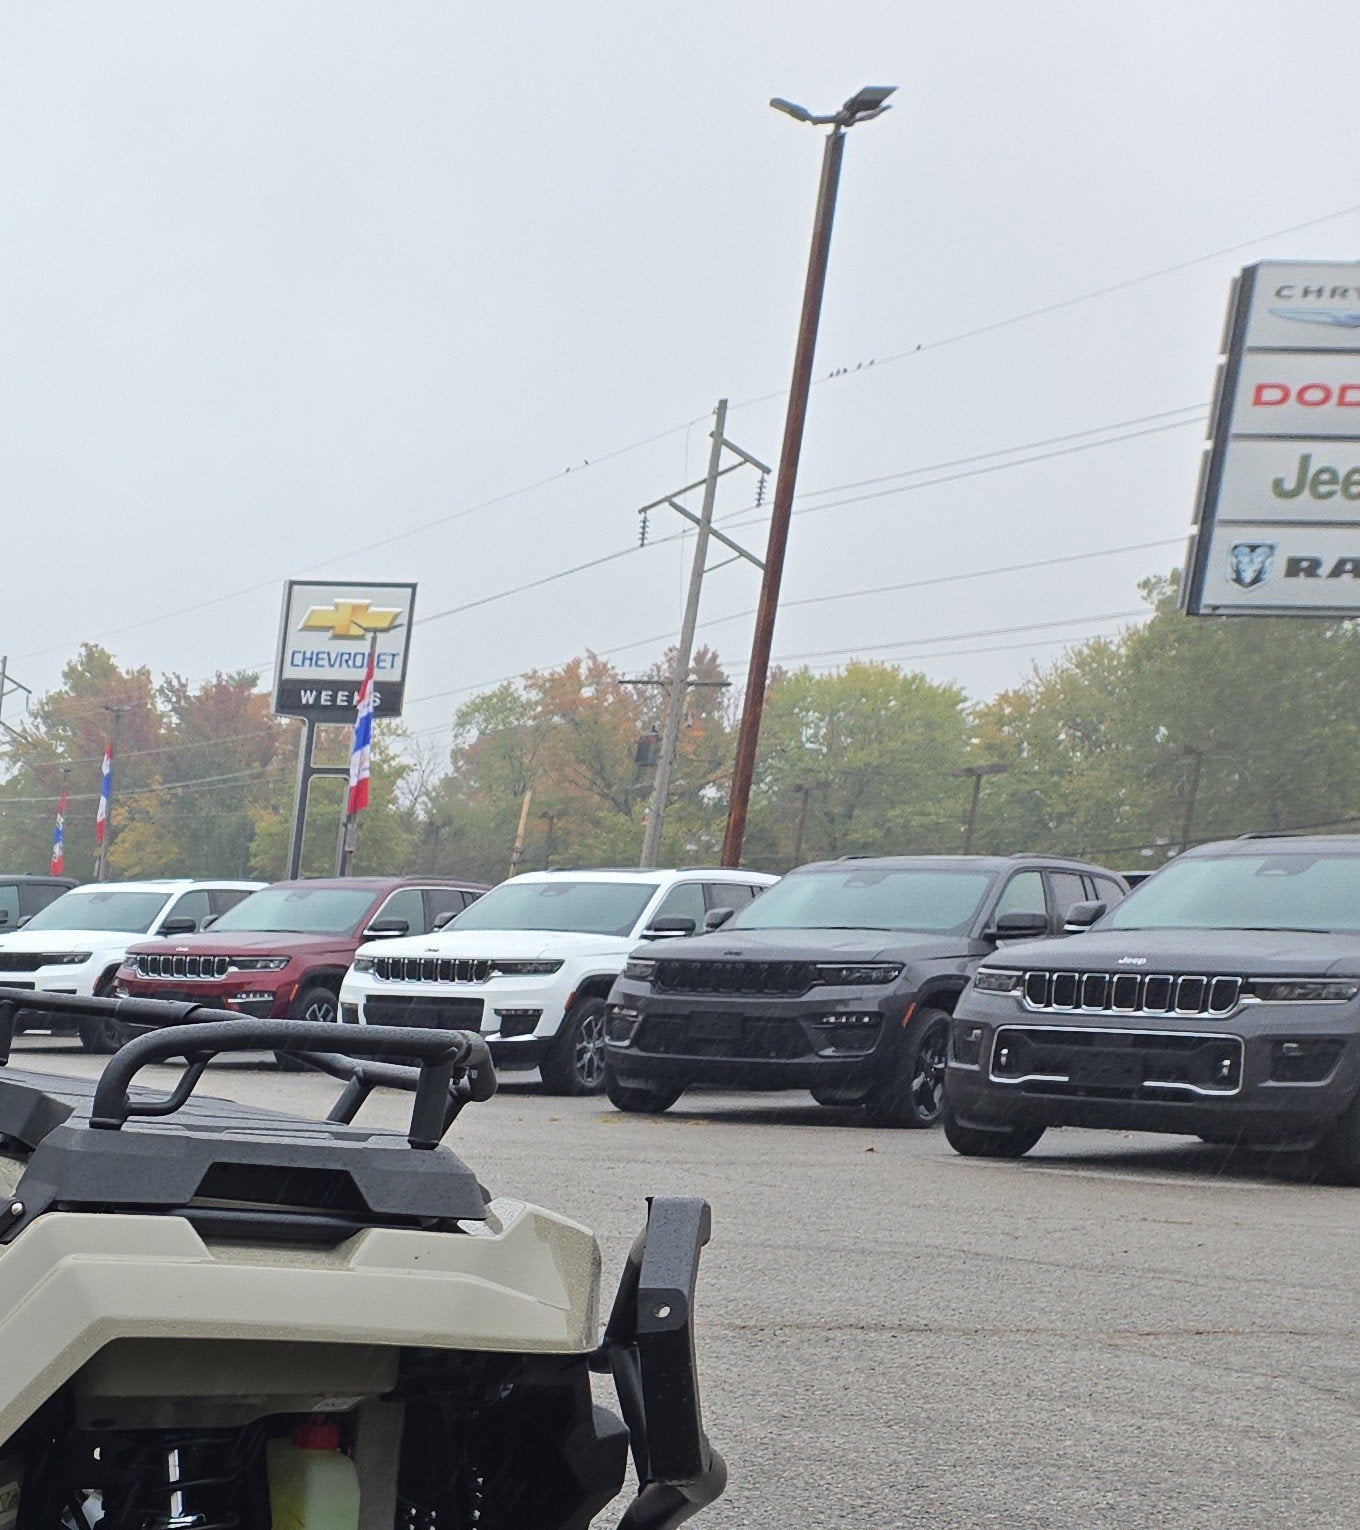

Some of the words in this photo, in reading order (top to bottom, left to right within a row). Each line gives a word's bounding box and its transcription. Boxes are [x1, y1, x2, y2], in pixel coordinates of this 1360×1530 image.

[1272, 453, 1360, 499] Jee
[1284, 556, 1360, 578] RA
[290, 650, 399, 670] CHEVROET
